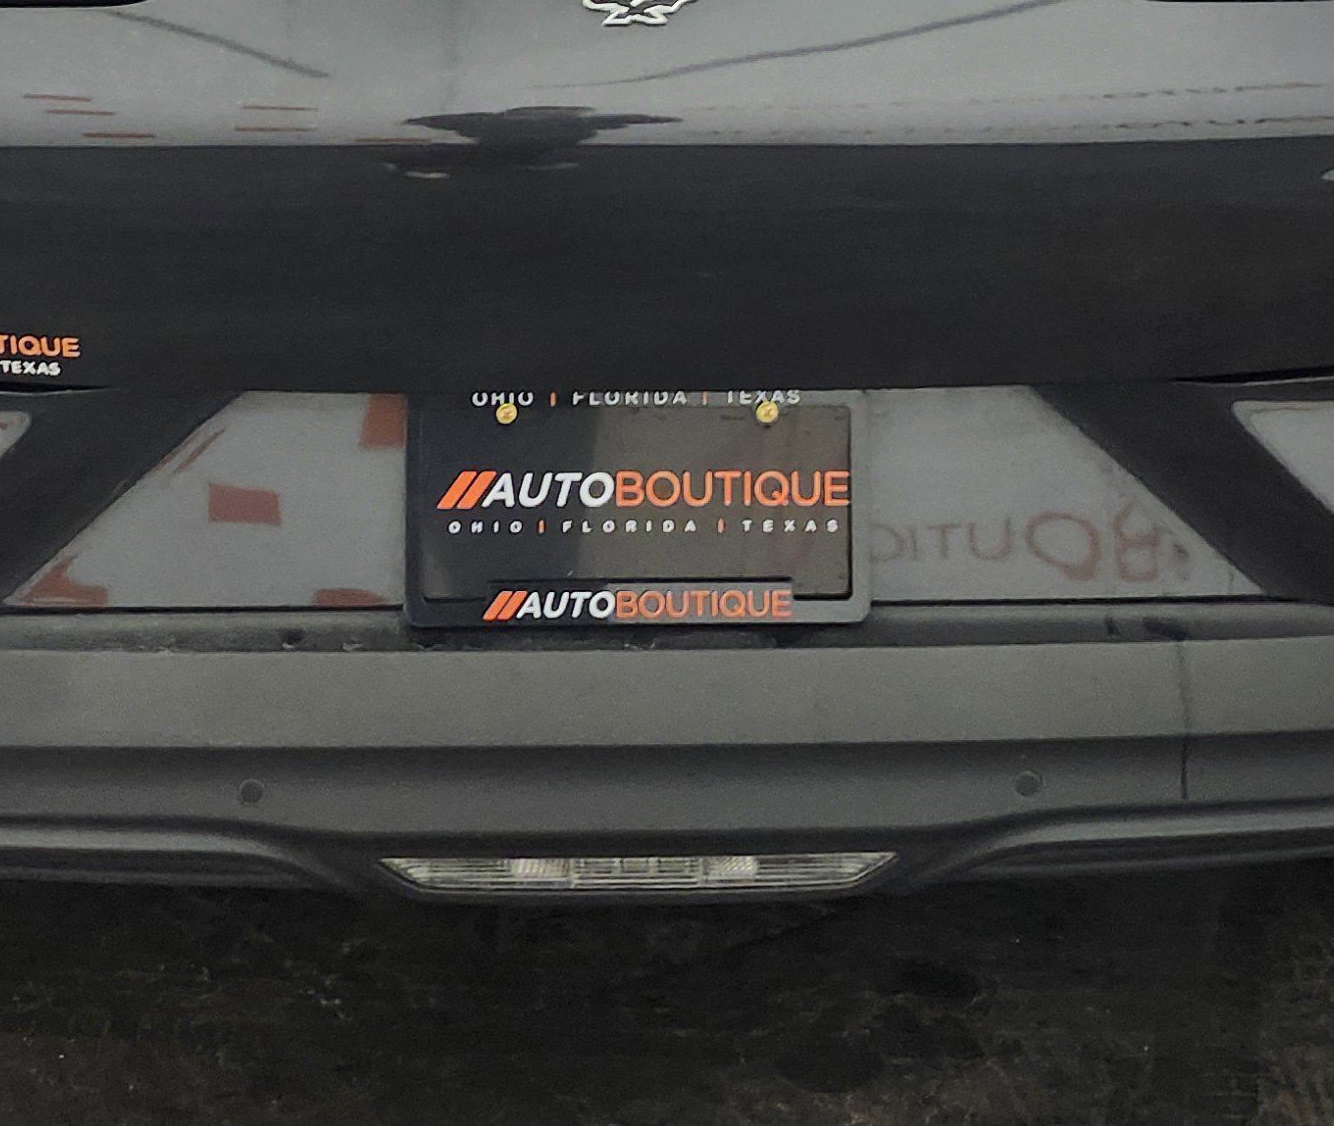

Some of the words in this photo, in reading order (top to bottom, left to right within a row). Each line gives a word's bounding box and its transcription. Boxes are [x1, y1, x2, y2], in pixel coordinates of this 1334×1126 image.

[0, 359, 61, 377] TEXAS
[482, 470, 850, 508] AUTOBOUTIQUE
[448, 520, 523, 534] OHIO
[562, 519, 697, 534] FLORIDA
[741, 519, 840, 534] TEXAS
[515, 590, 793, 619] AUTOBOUTIQUE
